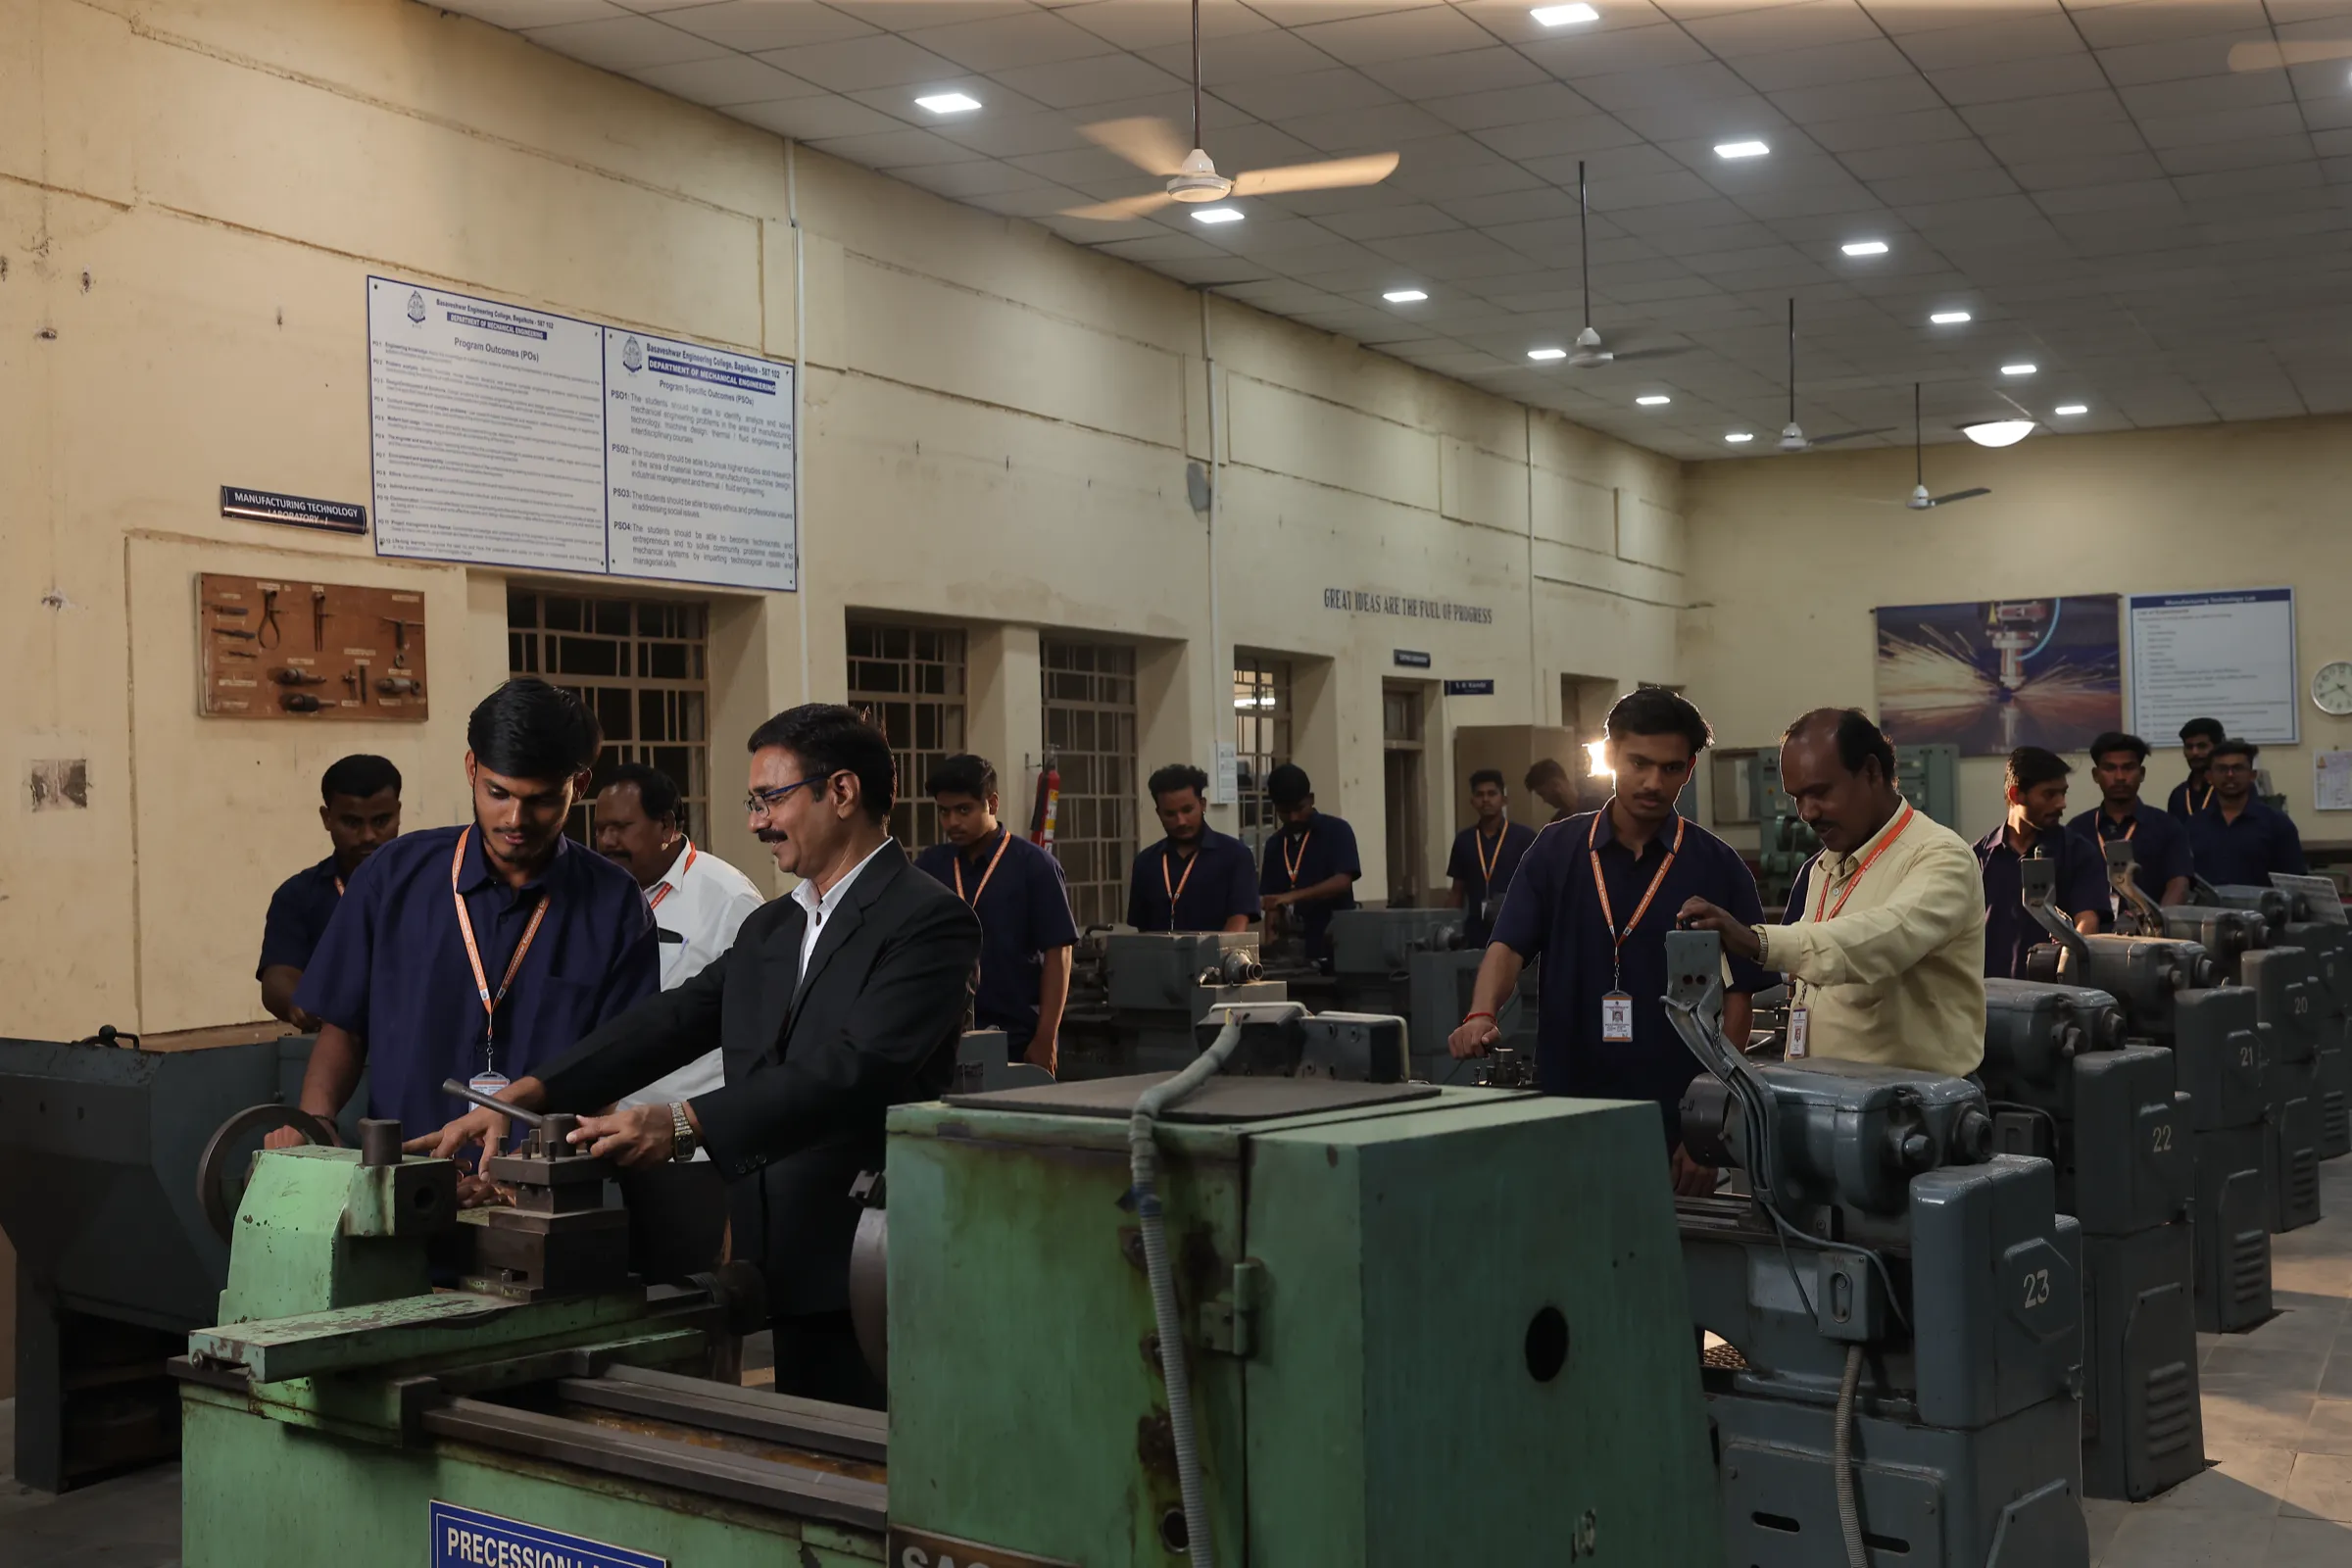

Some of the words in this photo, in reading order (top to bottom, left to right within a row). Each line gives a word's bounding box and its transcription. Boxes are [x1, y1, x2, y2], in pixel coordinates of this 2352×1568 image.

[467, 305, 493, 317] Engineering
[451, 314, 479, 326] DEPARTMENT
[516, 327, 543, 339] ENGINEERING
[455, 337, 484, 353] Program
[486, 343, 519, 358] Outcomes
[521, 349, 539, 363] (POs)
[647, 343, 681, 358] Basaveshwar
[683, 350, 712, 366] Engineering
[714, 357, 733, 371] College,
[735, 361, 758, 376] Bagalkote
[762, 367, 770, 377] 587
[650, 360, 689, 375] DEPARTMENT
[691, 368, 699, 377] OF
[701, 370, 737, 384] MECHANICAL
[739, 378, 776, 392] ENGINEERING
[660, 379, 683, 394] Program
[685, 384, 706, 398] Specific
[709, 389, 734, 402] Outcomes
[736, 394, 754, 407] (PSOs)
[631, 393, 641, 403] The
[646, 396, 668, 407] students
[767, 419, 776, 427] and
[631, 405, 661, 417] mechanical
[664, 411, 694, 425] engineering
[697, 416, 719, 428] problems
[759, 428, 791, 441] manufacturing
[612, 444, 631, 454] PSO2:
[632, 447, 642, 457] The
[644, 450, 666, 461] students
[752, 437, 780, 449] engineering
[783, 442, 791, 450] and
[632, 470, 657, 480] industrial
[639, 460, 647, 468] the
[663, 462, 669, 471] of
[235, 492, 306, 511] MANUFACTURING
[307, 502, 358, 518] TECHNOLOGY
[614, 488, 632, 498] PSO3:
[633, 491, 642, 500] The
[644, 493, 666, 503] students
[667, 496, 684, 505] should
[268, 510, 319, 524] LABORATORY
[638, 503, 666, 515] addressing
[668, 508, 683, 516] social
[634, 524, 643, 532] The
[648, 526, 670, 535] students
[674, 529, 691, 538] should
[633, 535, 670, 547] entrepreneurs
[674, 540, 684, 548] and
[697, 542, 709, 550] solve
[714, 544, 739, 555] community
[633, 546, 663, 556] mechanical
[668, 550, 689, 560] systems
[693, 552, 700, 561] by
[1324, 588, 1351, 611] GREAT
[1355, 591, 1381, 613] IDEAS
[1383, 596, 1399, 615] ARE
[1402, 598, 1418, 617] THE
[1420, 600, 1441, 619] FUEL
[1443, 603, 1452, 620] OF
[1454, 604, 1492, 624] PROGRESS
[522, 908, 543, 944] Engineering
[2295, 996, 2308, 1014] 20
[2240, 1046, 2253, 1067] 21
[2153, 1125, 2171, 1152] 22
[2023, 1269, 2050, 1309] 23
